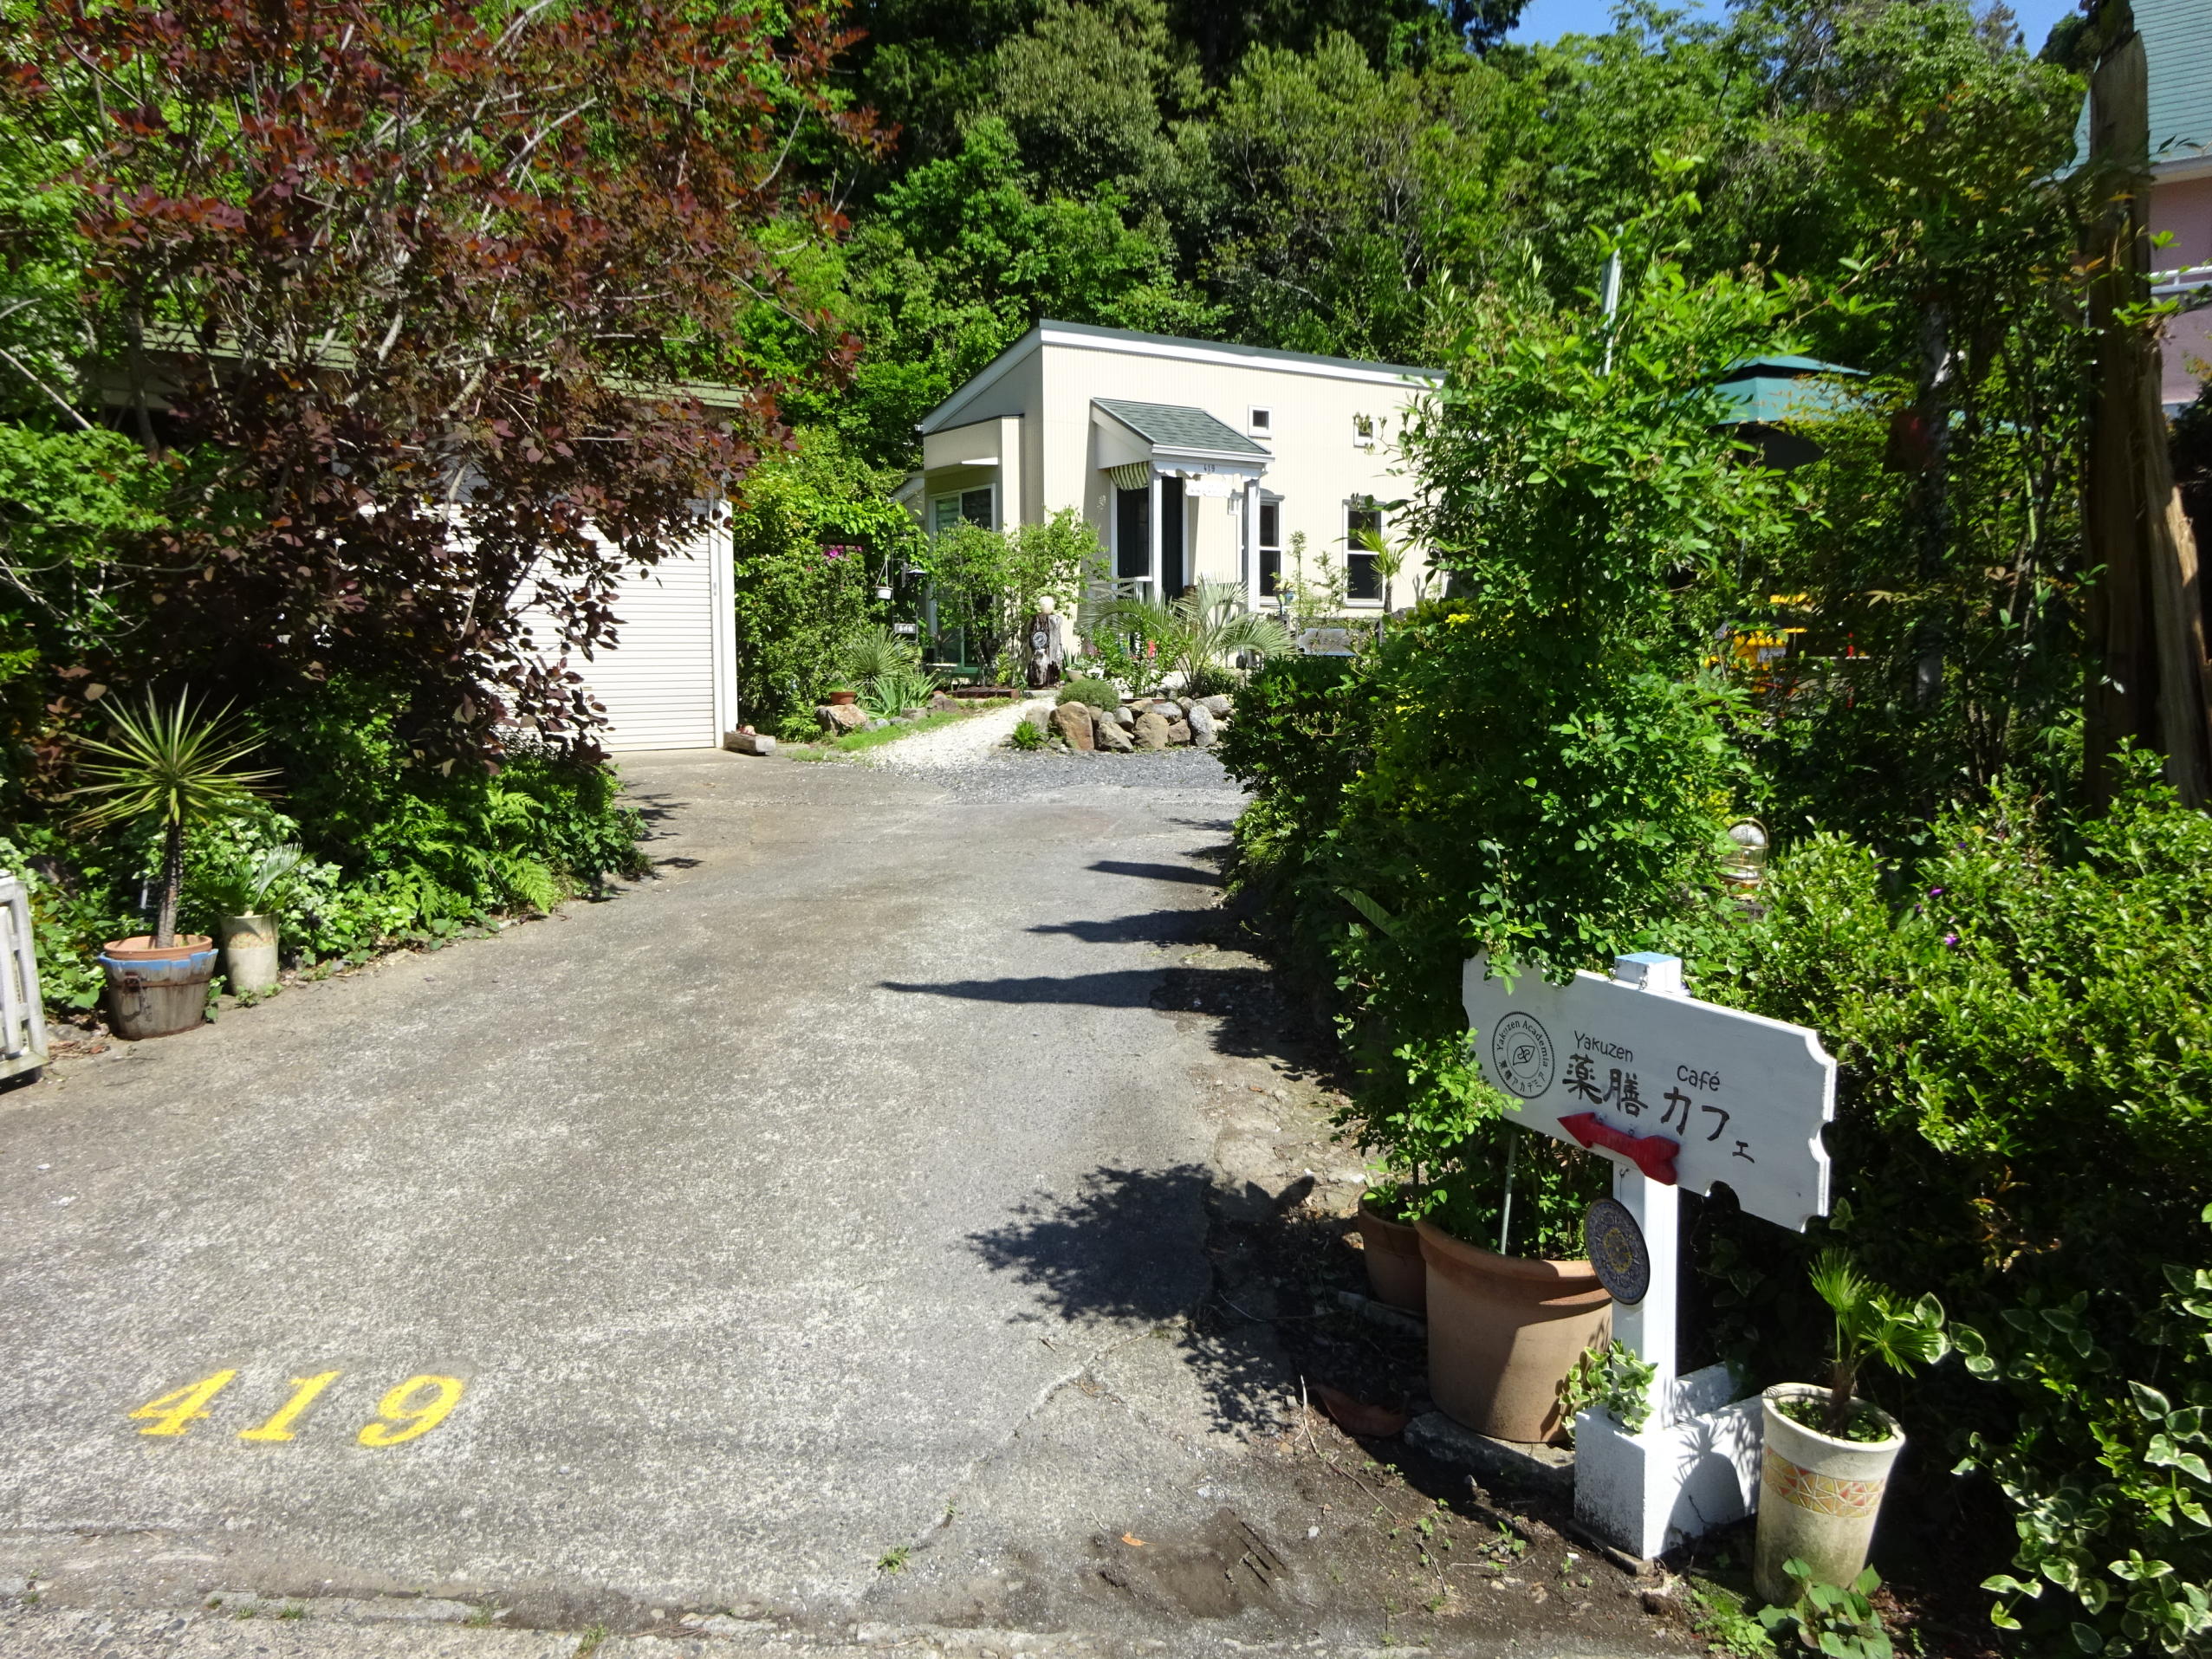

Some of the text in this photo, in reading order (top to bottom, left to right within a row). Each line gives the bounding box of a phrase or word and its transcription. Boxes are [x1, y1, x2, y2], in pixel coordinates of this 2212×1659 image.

[1497, 1021, 1549, 1067] Yakuzen Academia
[1574, 1030, 1721, 1092] Yakuzen café
[1562, 1053, 1755, 1163] 薬膳カフェ
[128, 1369, 464, 1447] 419
